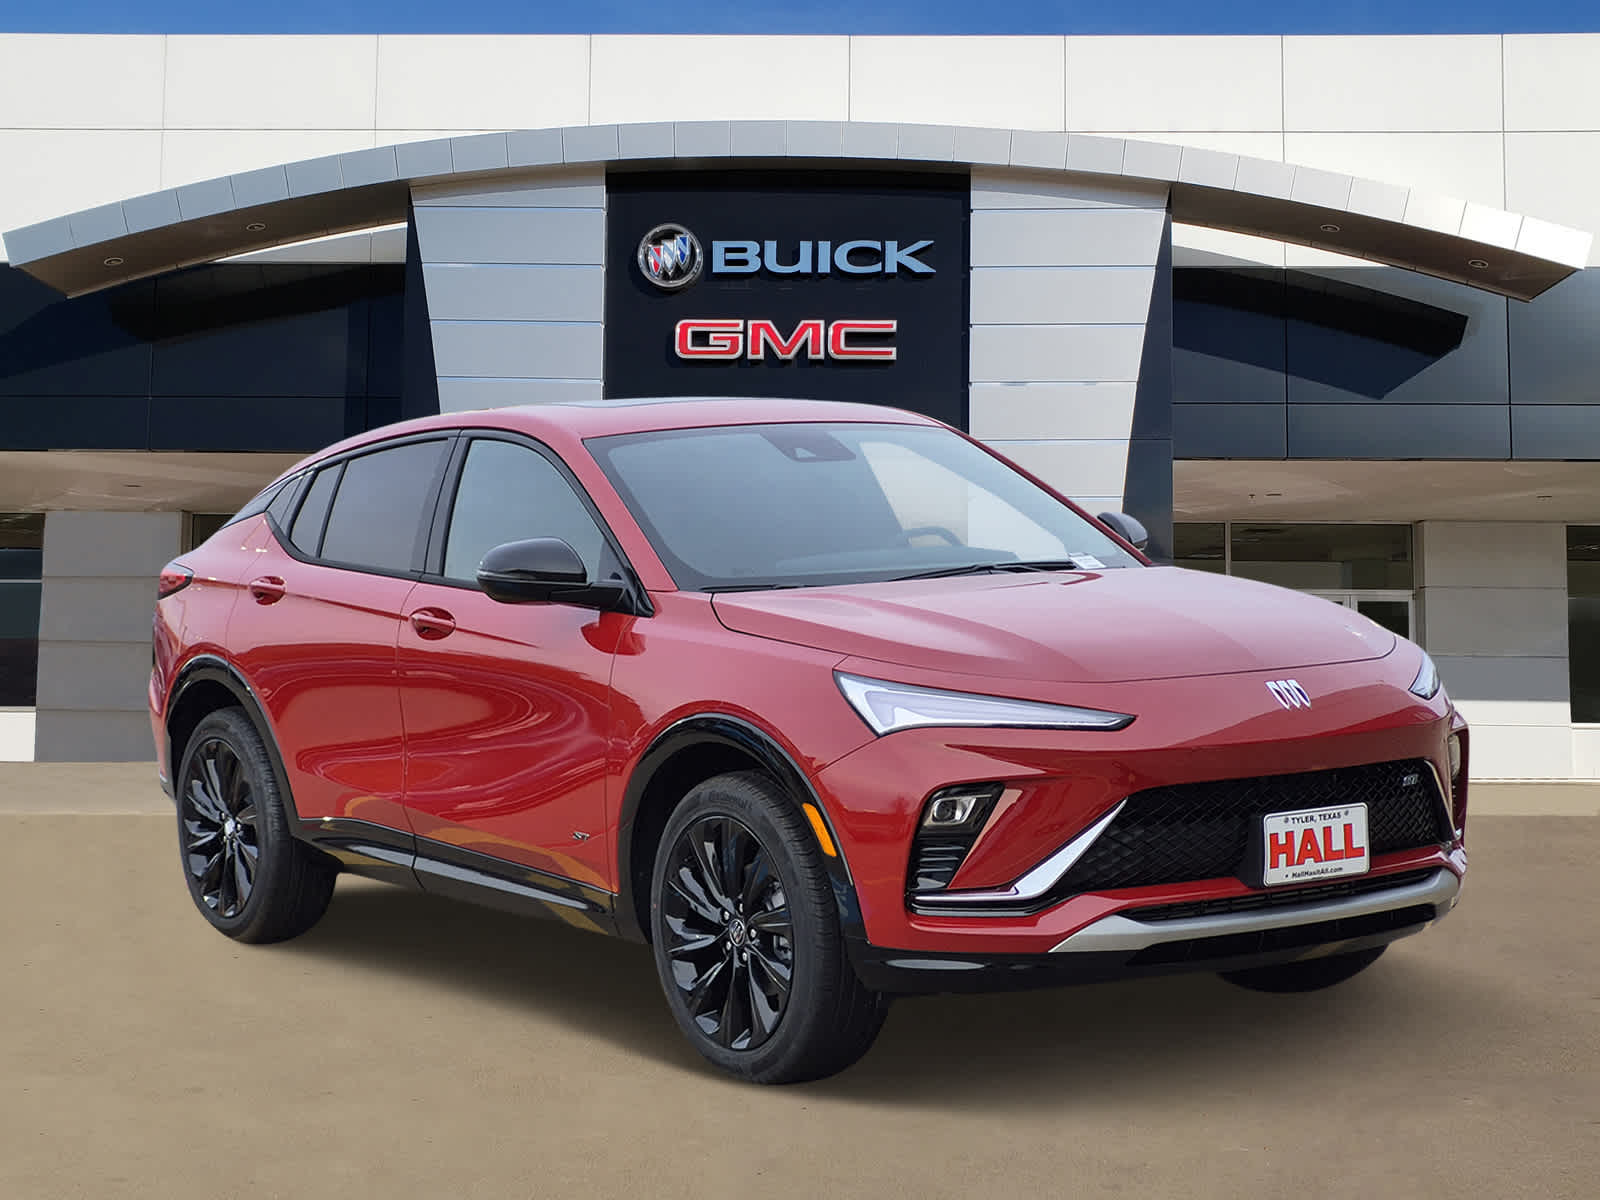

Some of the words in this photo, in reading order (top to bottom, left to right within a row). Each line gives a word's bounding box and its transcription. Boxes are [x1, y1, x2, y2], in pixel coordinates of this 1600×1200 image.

[711, 240, 937, 273] BUICK
[674, 319, 897, 360] GMC
[1319, 811, 1341, 821] TEXAS
[1269, 823, 1365, 869] HALL
